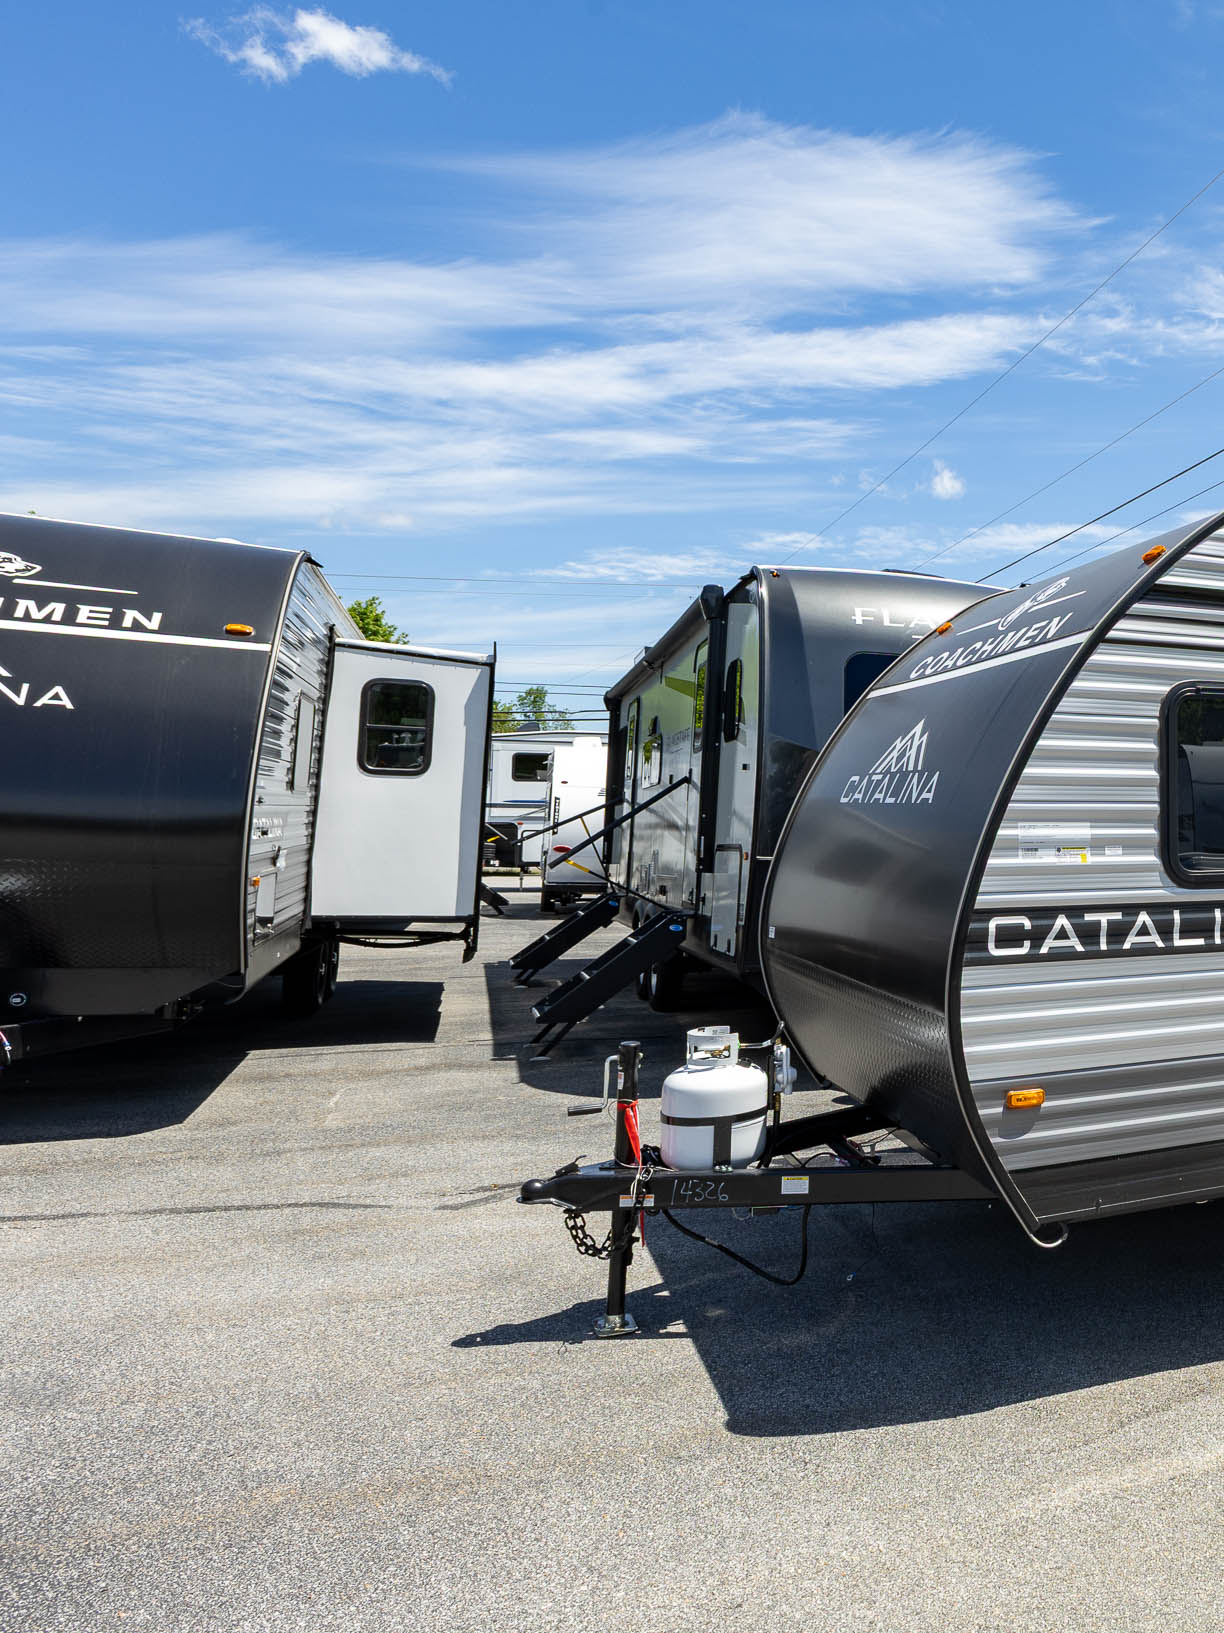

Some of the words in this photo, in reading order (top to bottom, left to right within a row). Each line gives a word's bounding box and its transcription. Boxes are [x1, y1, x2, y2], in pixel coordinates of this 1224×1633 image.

[0, 597, 163, 630] MEN
[909, 612, 1073, 679] COACHMEN
[840, 771, 940, 804] CATALINA
[671, 1179, 729, 1206] 14326
